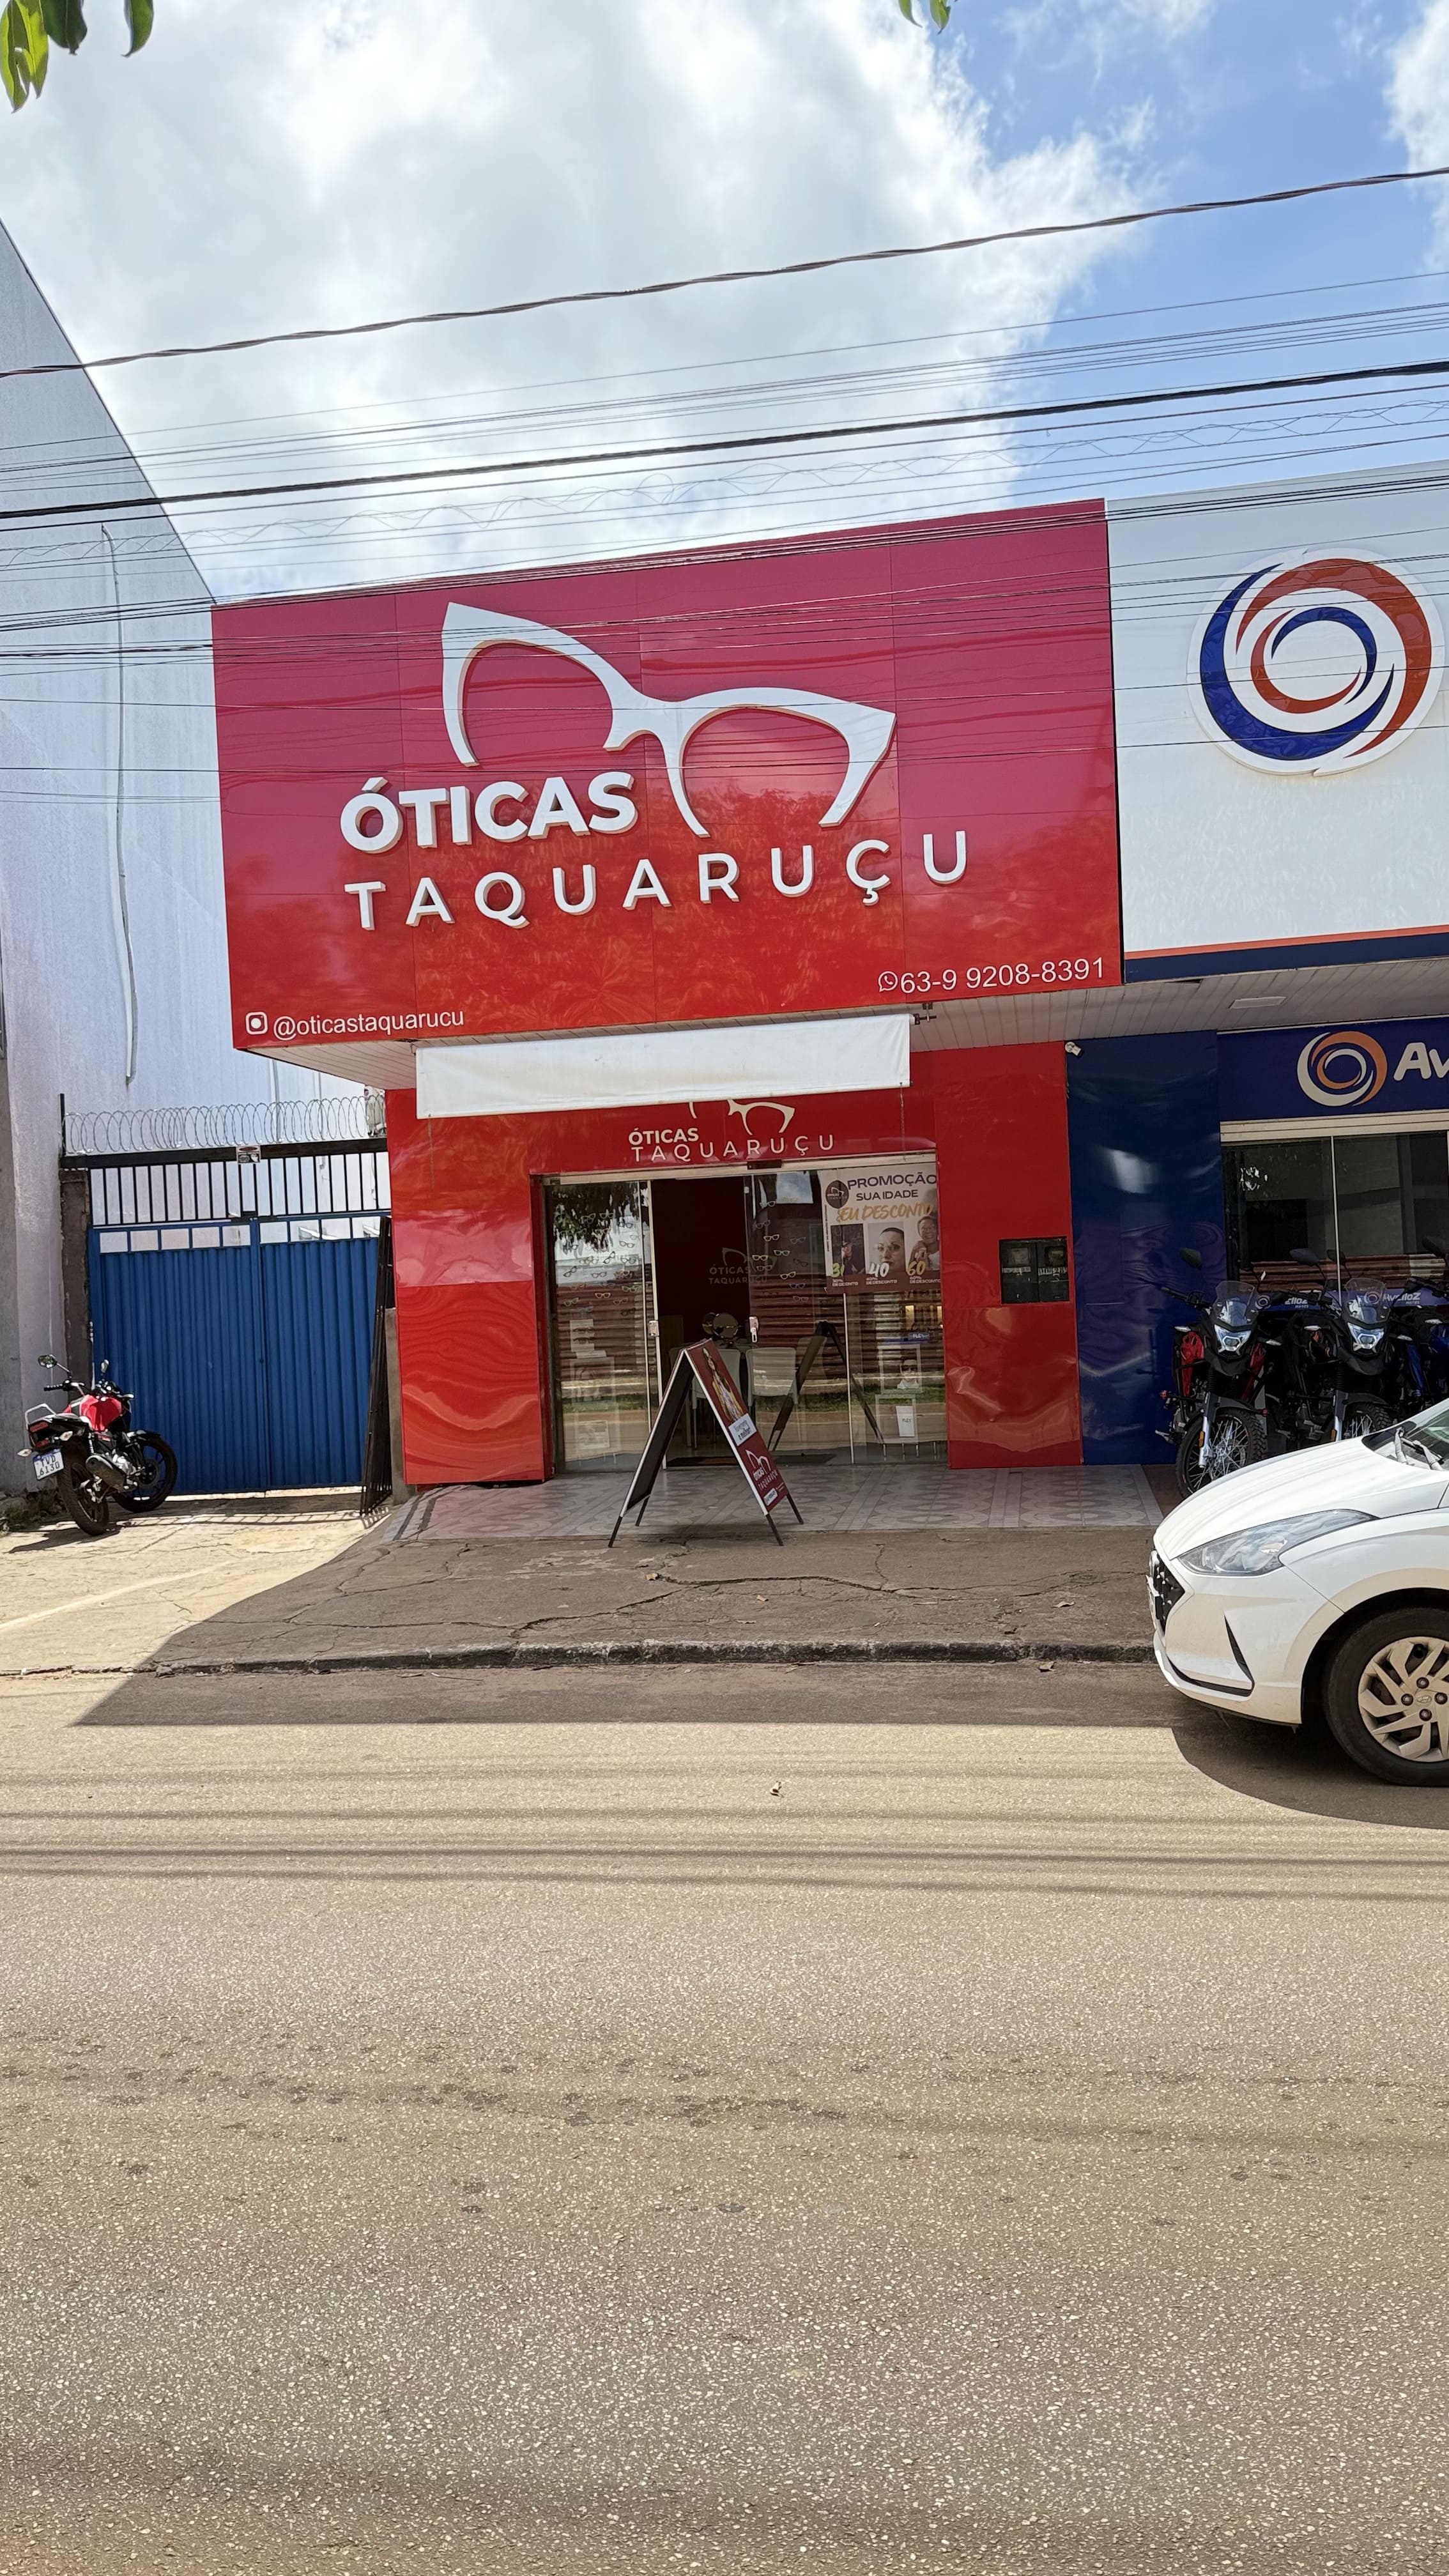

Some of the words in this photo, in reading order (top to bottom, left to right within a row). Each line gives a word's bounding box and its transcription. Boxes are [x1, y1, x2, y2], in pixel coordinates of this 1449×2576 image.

[340, 771, 639, 854] ÓTICAS
[344, 830, 968, 931] TAQUARUÇU
[900, 969, 957, 994] 63-9
[965, 957, 1103, 988] 9208-8391
[273, 1010, 464, 1041] @oticastaquarucu
[628, 1127, 700, 1146] ÓTICAS
[631, 1135, 834, 1162] TAQUARUÇU
[847, 1172, 937, 1190] PROMOÇÃO
[856, 1192, 881, 1201] SUA
[882, 1190, 919, 1200] IDADE
[868, 1261, 890, 1278] 40
[907, 1261, 926, 1276] 60
